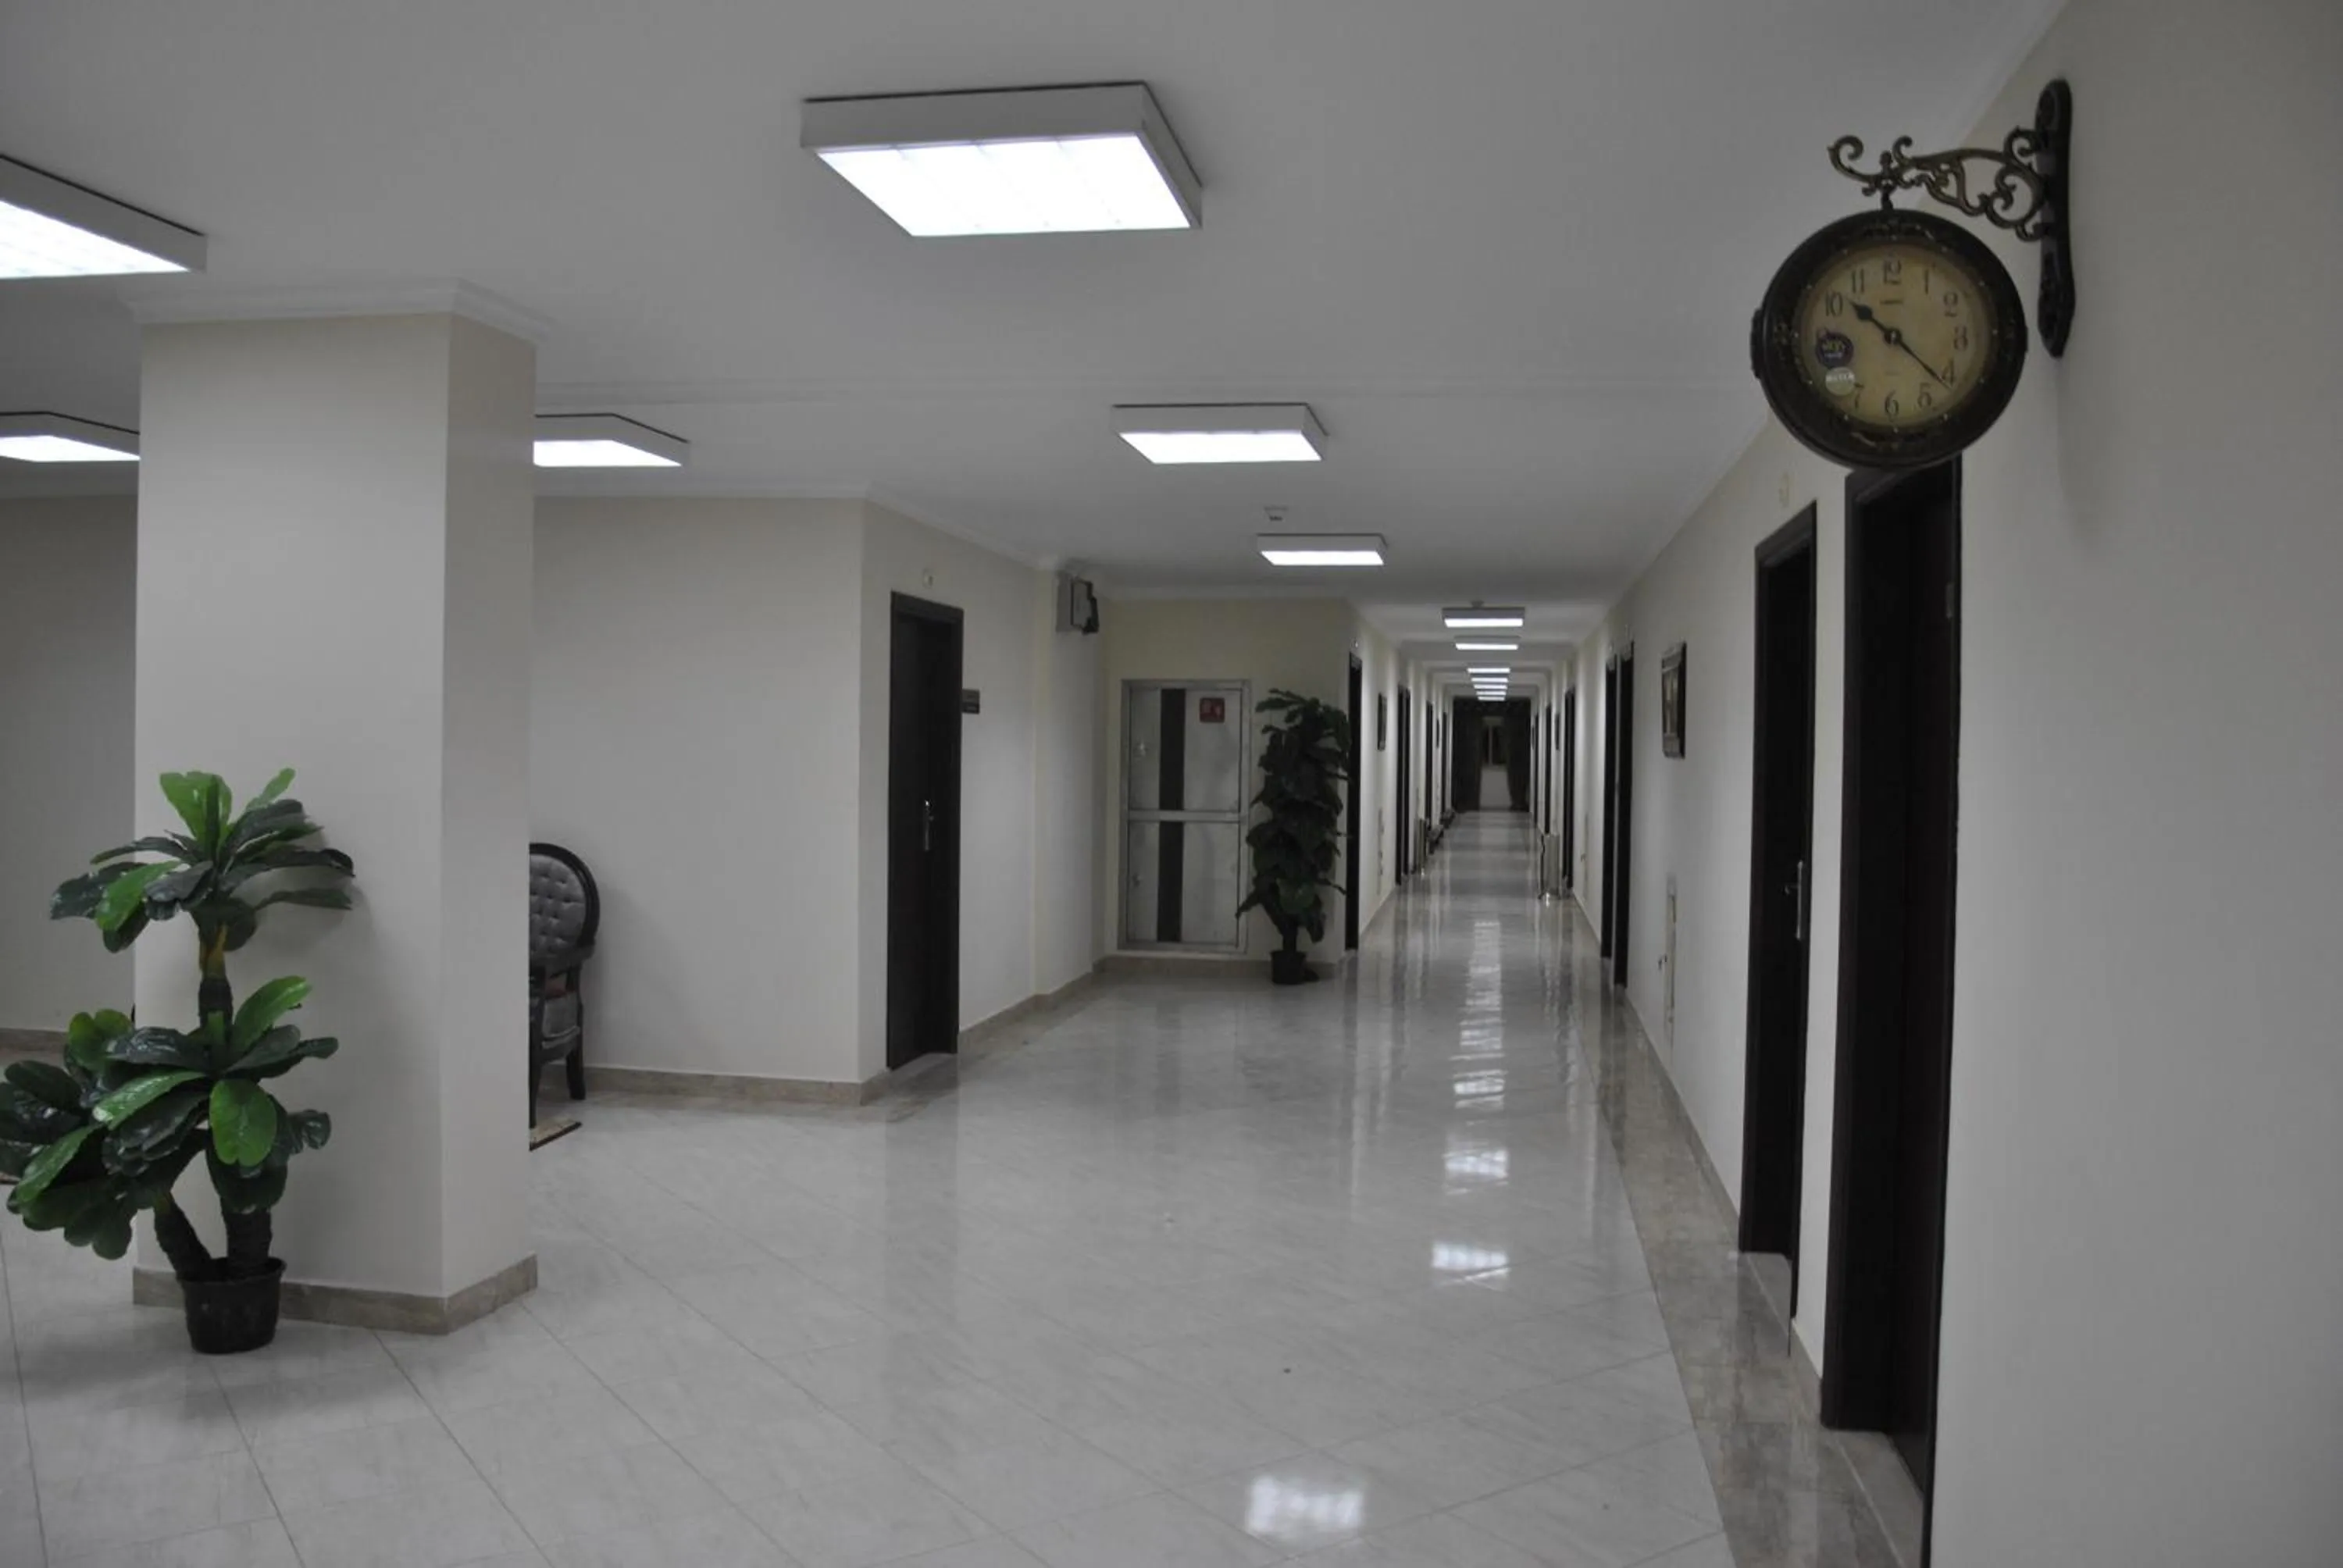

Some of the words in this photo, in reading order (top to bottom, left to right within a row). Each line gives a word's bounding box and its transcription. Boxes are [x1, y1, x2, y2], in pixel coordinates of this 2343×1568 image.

[1851, 269, 1865, 294] 11
[1883, 256, 1903, 285] 12
[1924, 269, 1929, 294] 1
[1825, 291, 1843, 317] 10
[1943, 292, 1958, 318] 2
[1953, 326, 1968, 351] 3
[1940, 358, 1955, 385] 4
[1885, 390, 1899, 422] 6
[1917, 382, 1932, 408] 5
